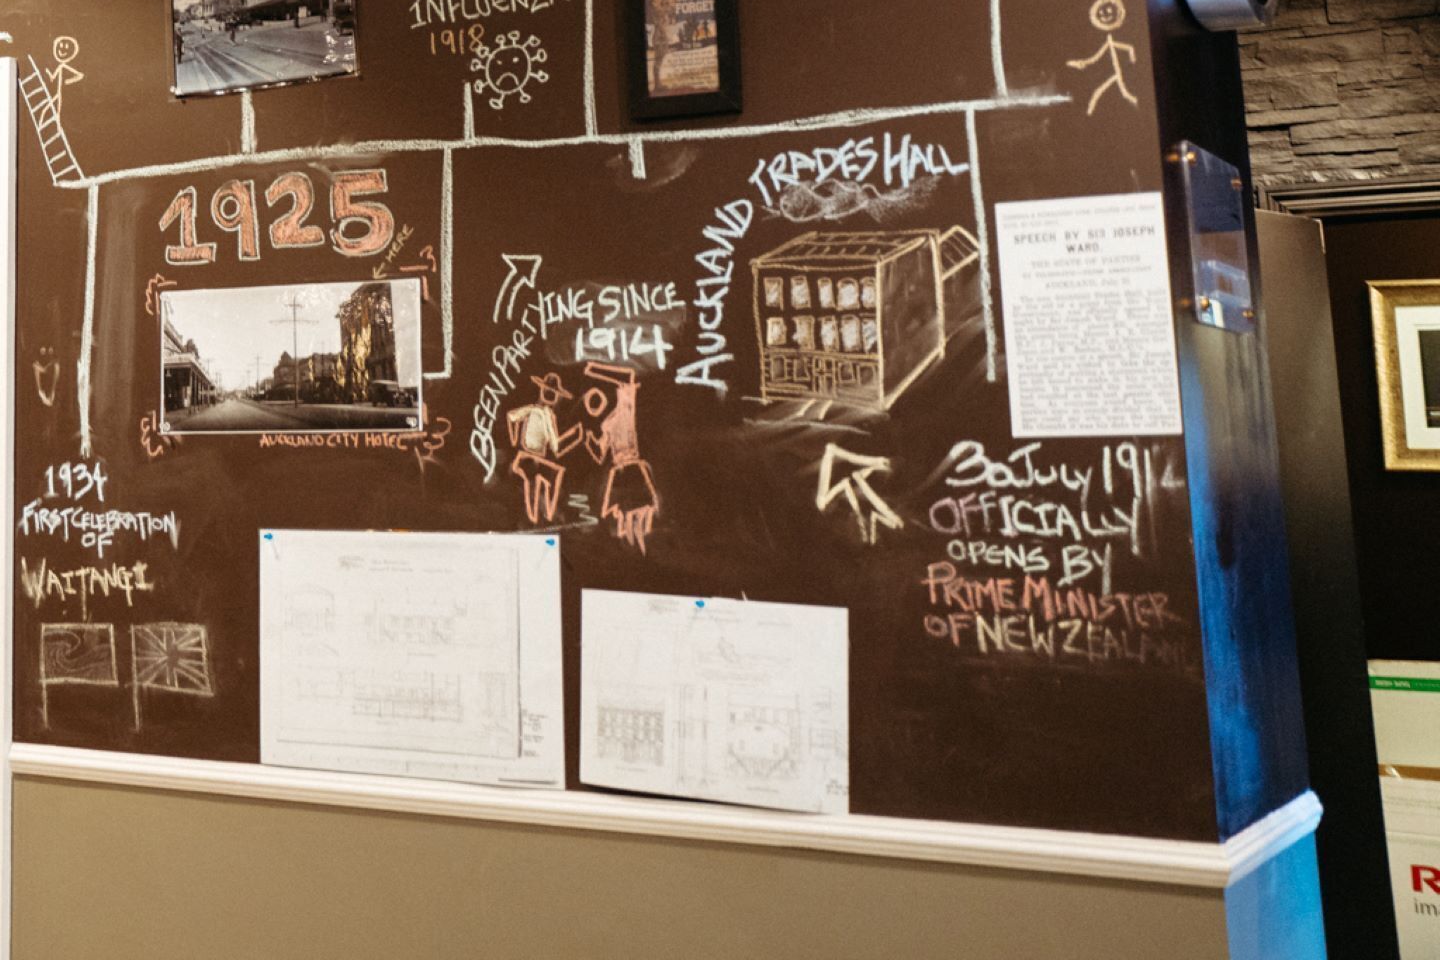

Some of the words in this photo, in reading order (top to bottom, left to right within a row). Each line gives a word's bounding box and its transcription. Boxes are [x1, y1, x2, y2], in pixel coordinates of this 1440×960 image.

[674, 0, 716, 14] FORGET
[429, 24, 486, 55] 1918
[159, 168, 394, 266] 1925
[1014, 231, 1057, 245] SPEECH
[1064, 230, 1081, 241] BY
[1112, 225, 1156, 238] JOSEPH
[674, 197, 755, 392] AUCKLAND
[749, 137, 879, 206] TRADES
[881, 132, 971, 190] HALL
[574, 323, 674, 371] 1914
[469, 362, 512, 485] BEEN
[597, 281, 686, 322] SINCE
[326, 433, 360, 448] CITY
[45, 462, 108, 502] 1934
[70, 507, 180, 550] CELEBRATION
[81, 532, 114, 559] OF
[929, 489, 1142, 556] OFFICIALLY
[21, 556, 154, 610] WAITANGI
[921, 561, 1017, 612] PRIME
[947, 539, 1051, 572] OPENS
[1057, 543, 1112, 596] BY
[924, 612, 974, 648] OF
[973, 611, 1055, 657] NEW
